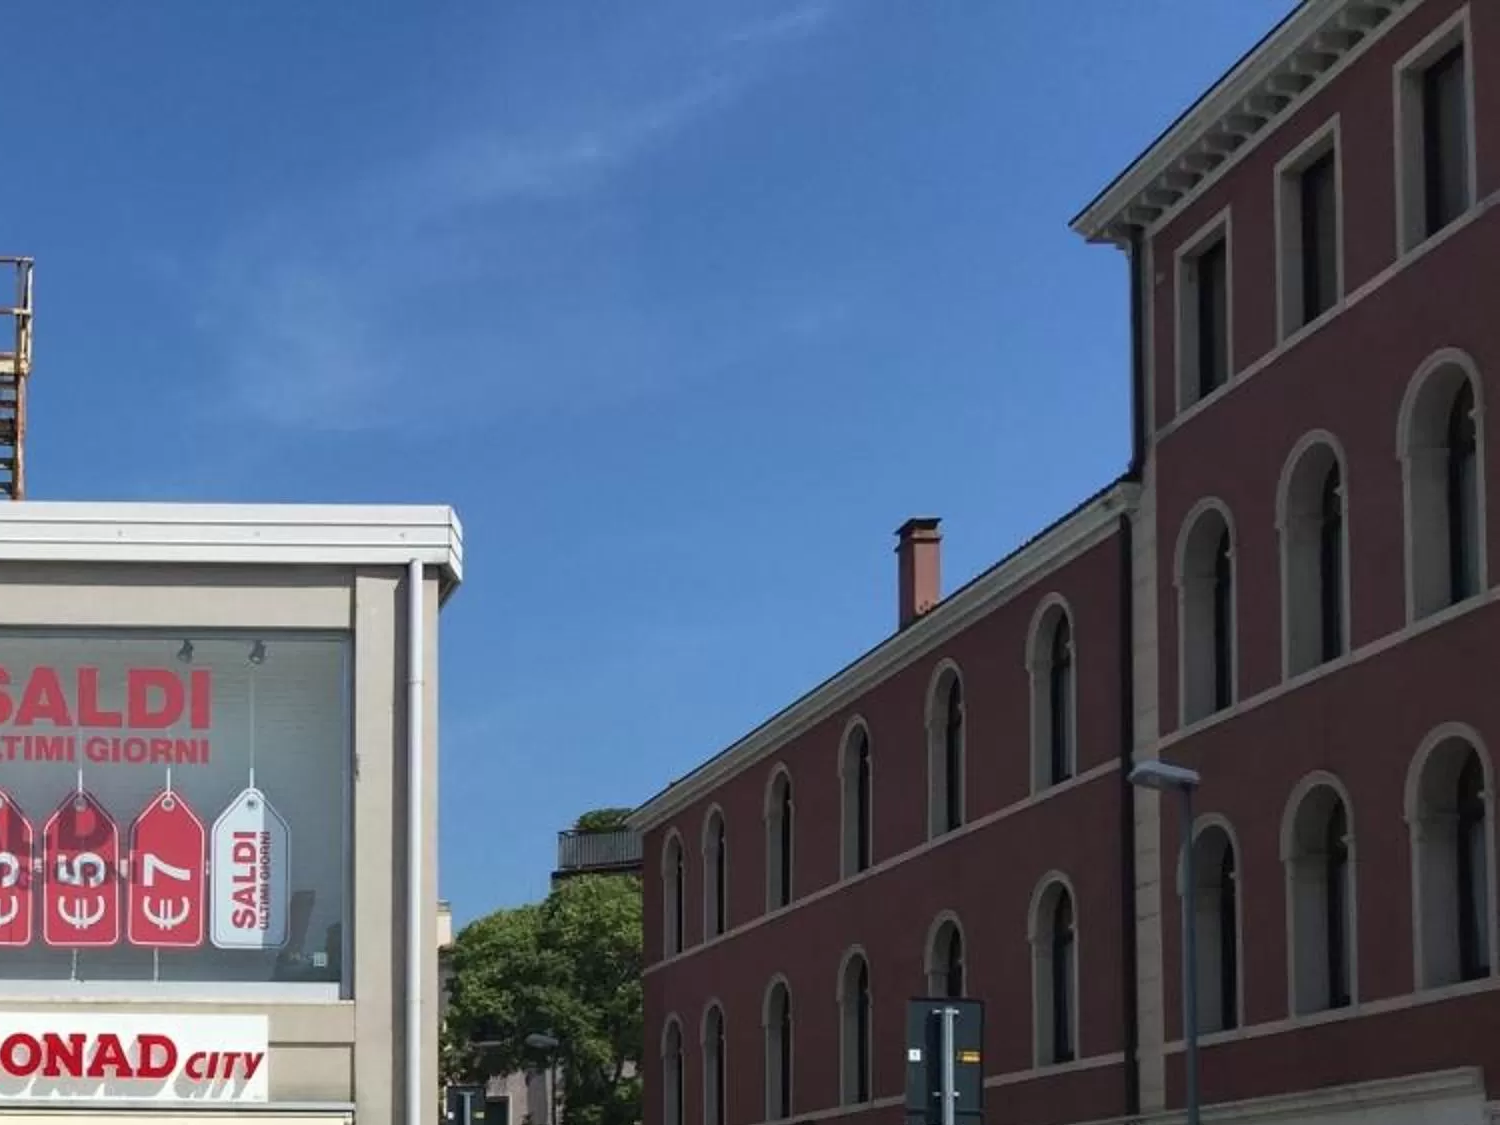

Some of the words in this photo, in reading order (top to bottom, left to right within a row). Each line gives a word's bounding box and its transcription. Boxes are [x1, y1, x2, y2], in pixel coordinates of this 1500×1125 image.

[84, 736, 211, 765] GIORNI
[259, 831, 271, 881] GIORNI
[232, 831, 257, 930] SALDI
[259, 883, 271, 931] ULTIMI
[184, 1050, 264, 1080] CITY
